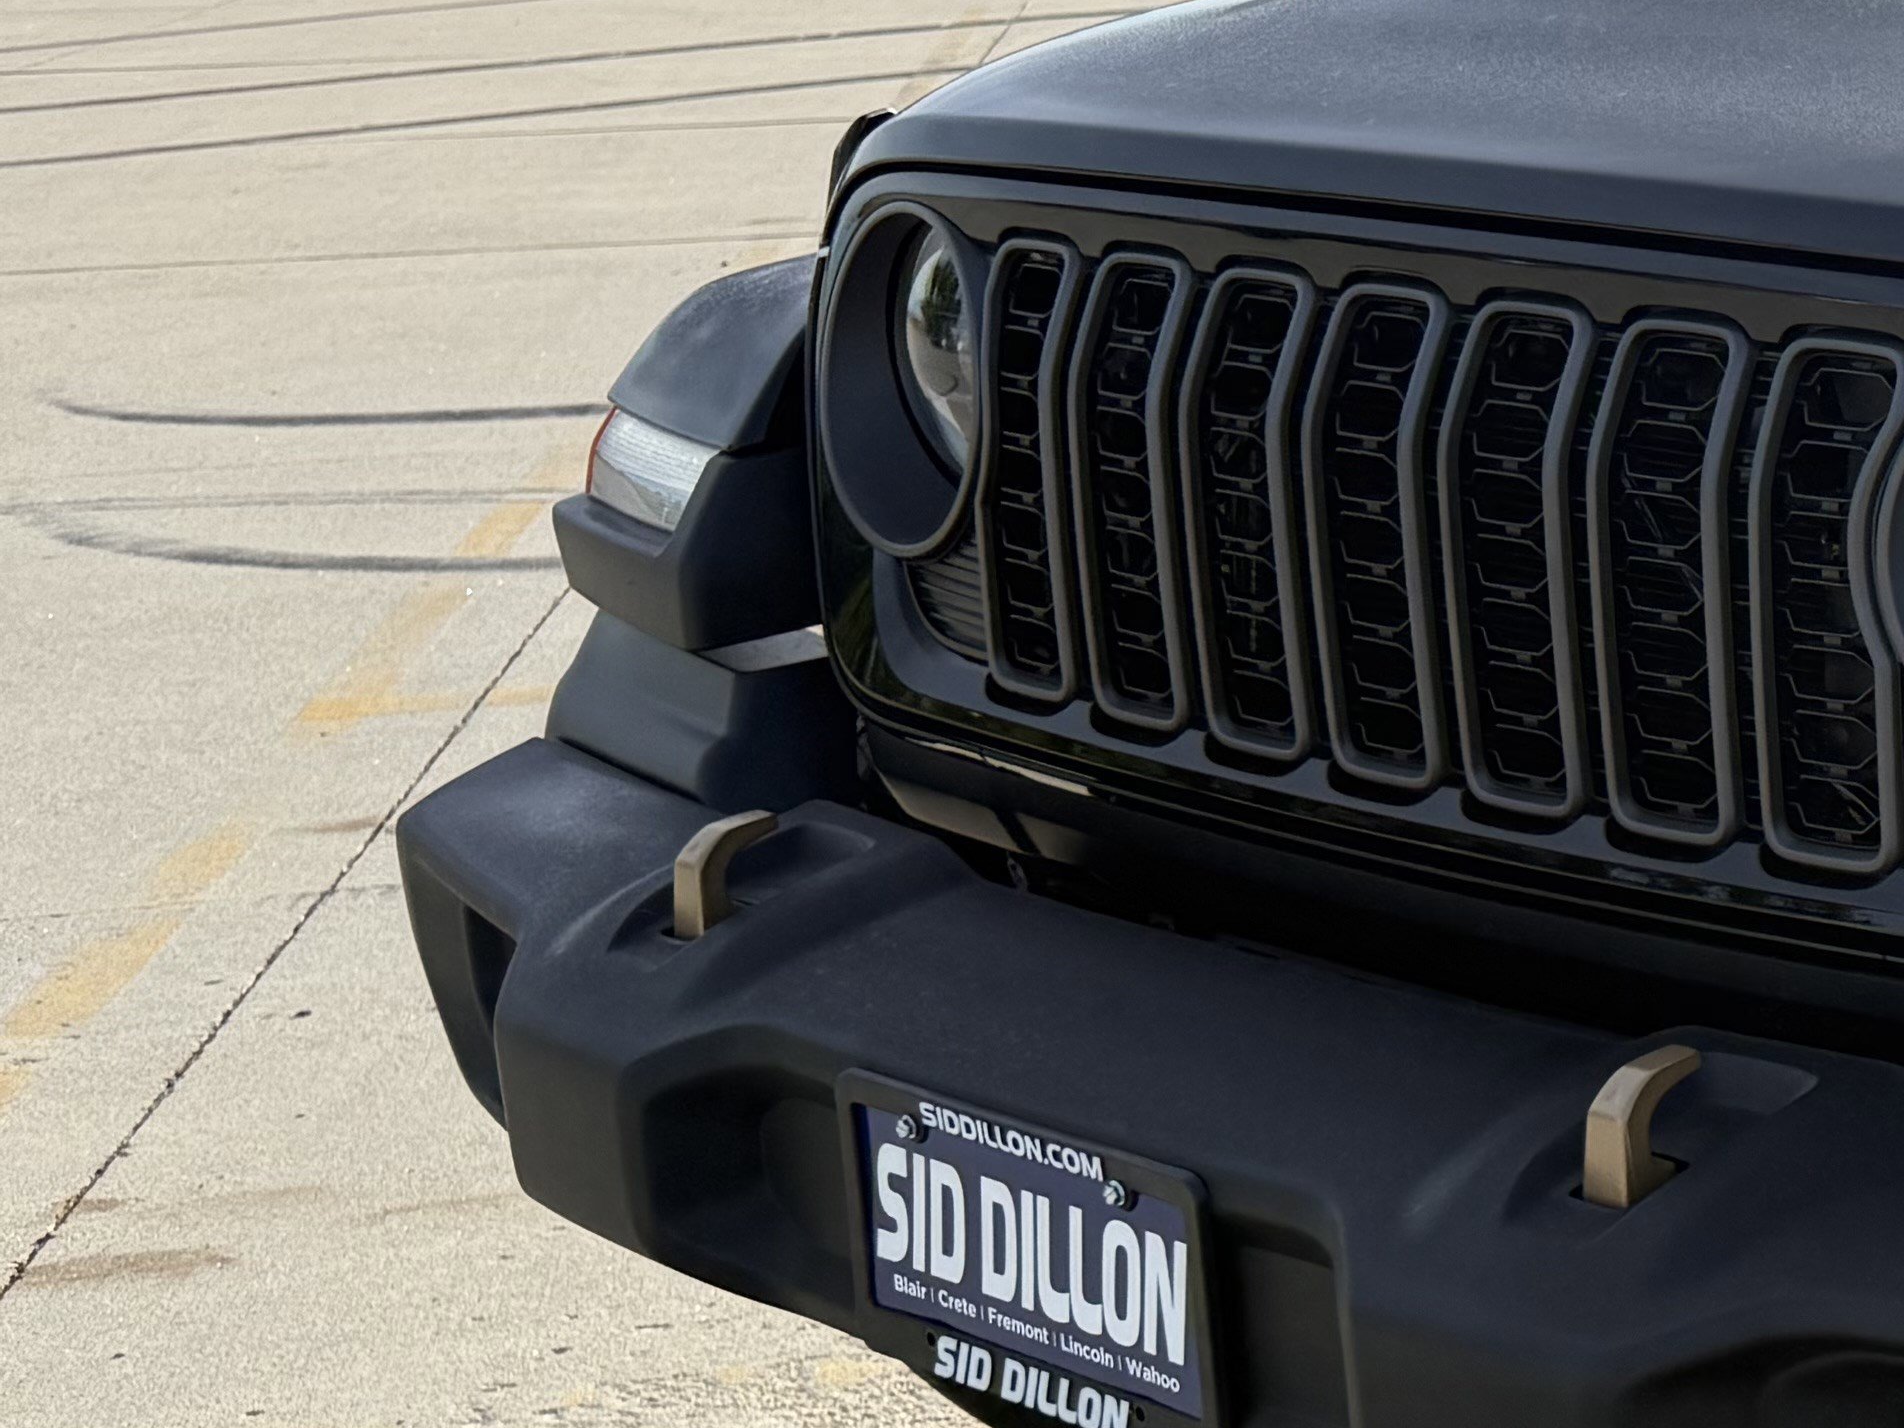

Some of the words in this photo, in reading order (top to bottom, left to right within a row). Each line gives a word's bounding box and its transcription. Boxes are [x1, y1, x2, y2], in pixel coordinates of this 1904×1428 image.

[918, 1101, 1105, 1183] SIDDILLON.COM
[875, 1142, 966, 1285] SID
[979, 1175, 1188, 1367] DILLON
[893, 1273, 927, 1301] Blair
[938, 1289, 978, 1319] Crete
[987, 1307, 1050, 1346] Fremont
[1060, 1332, 1115, 1370] Lincoln
[1126, 1356, 1181, 1394] Wahoo
[933, 1334, 993, 1392] SID
